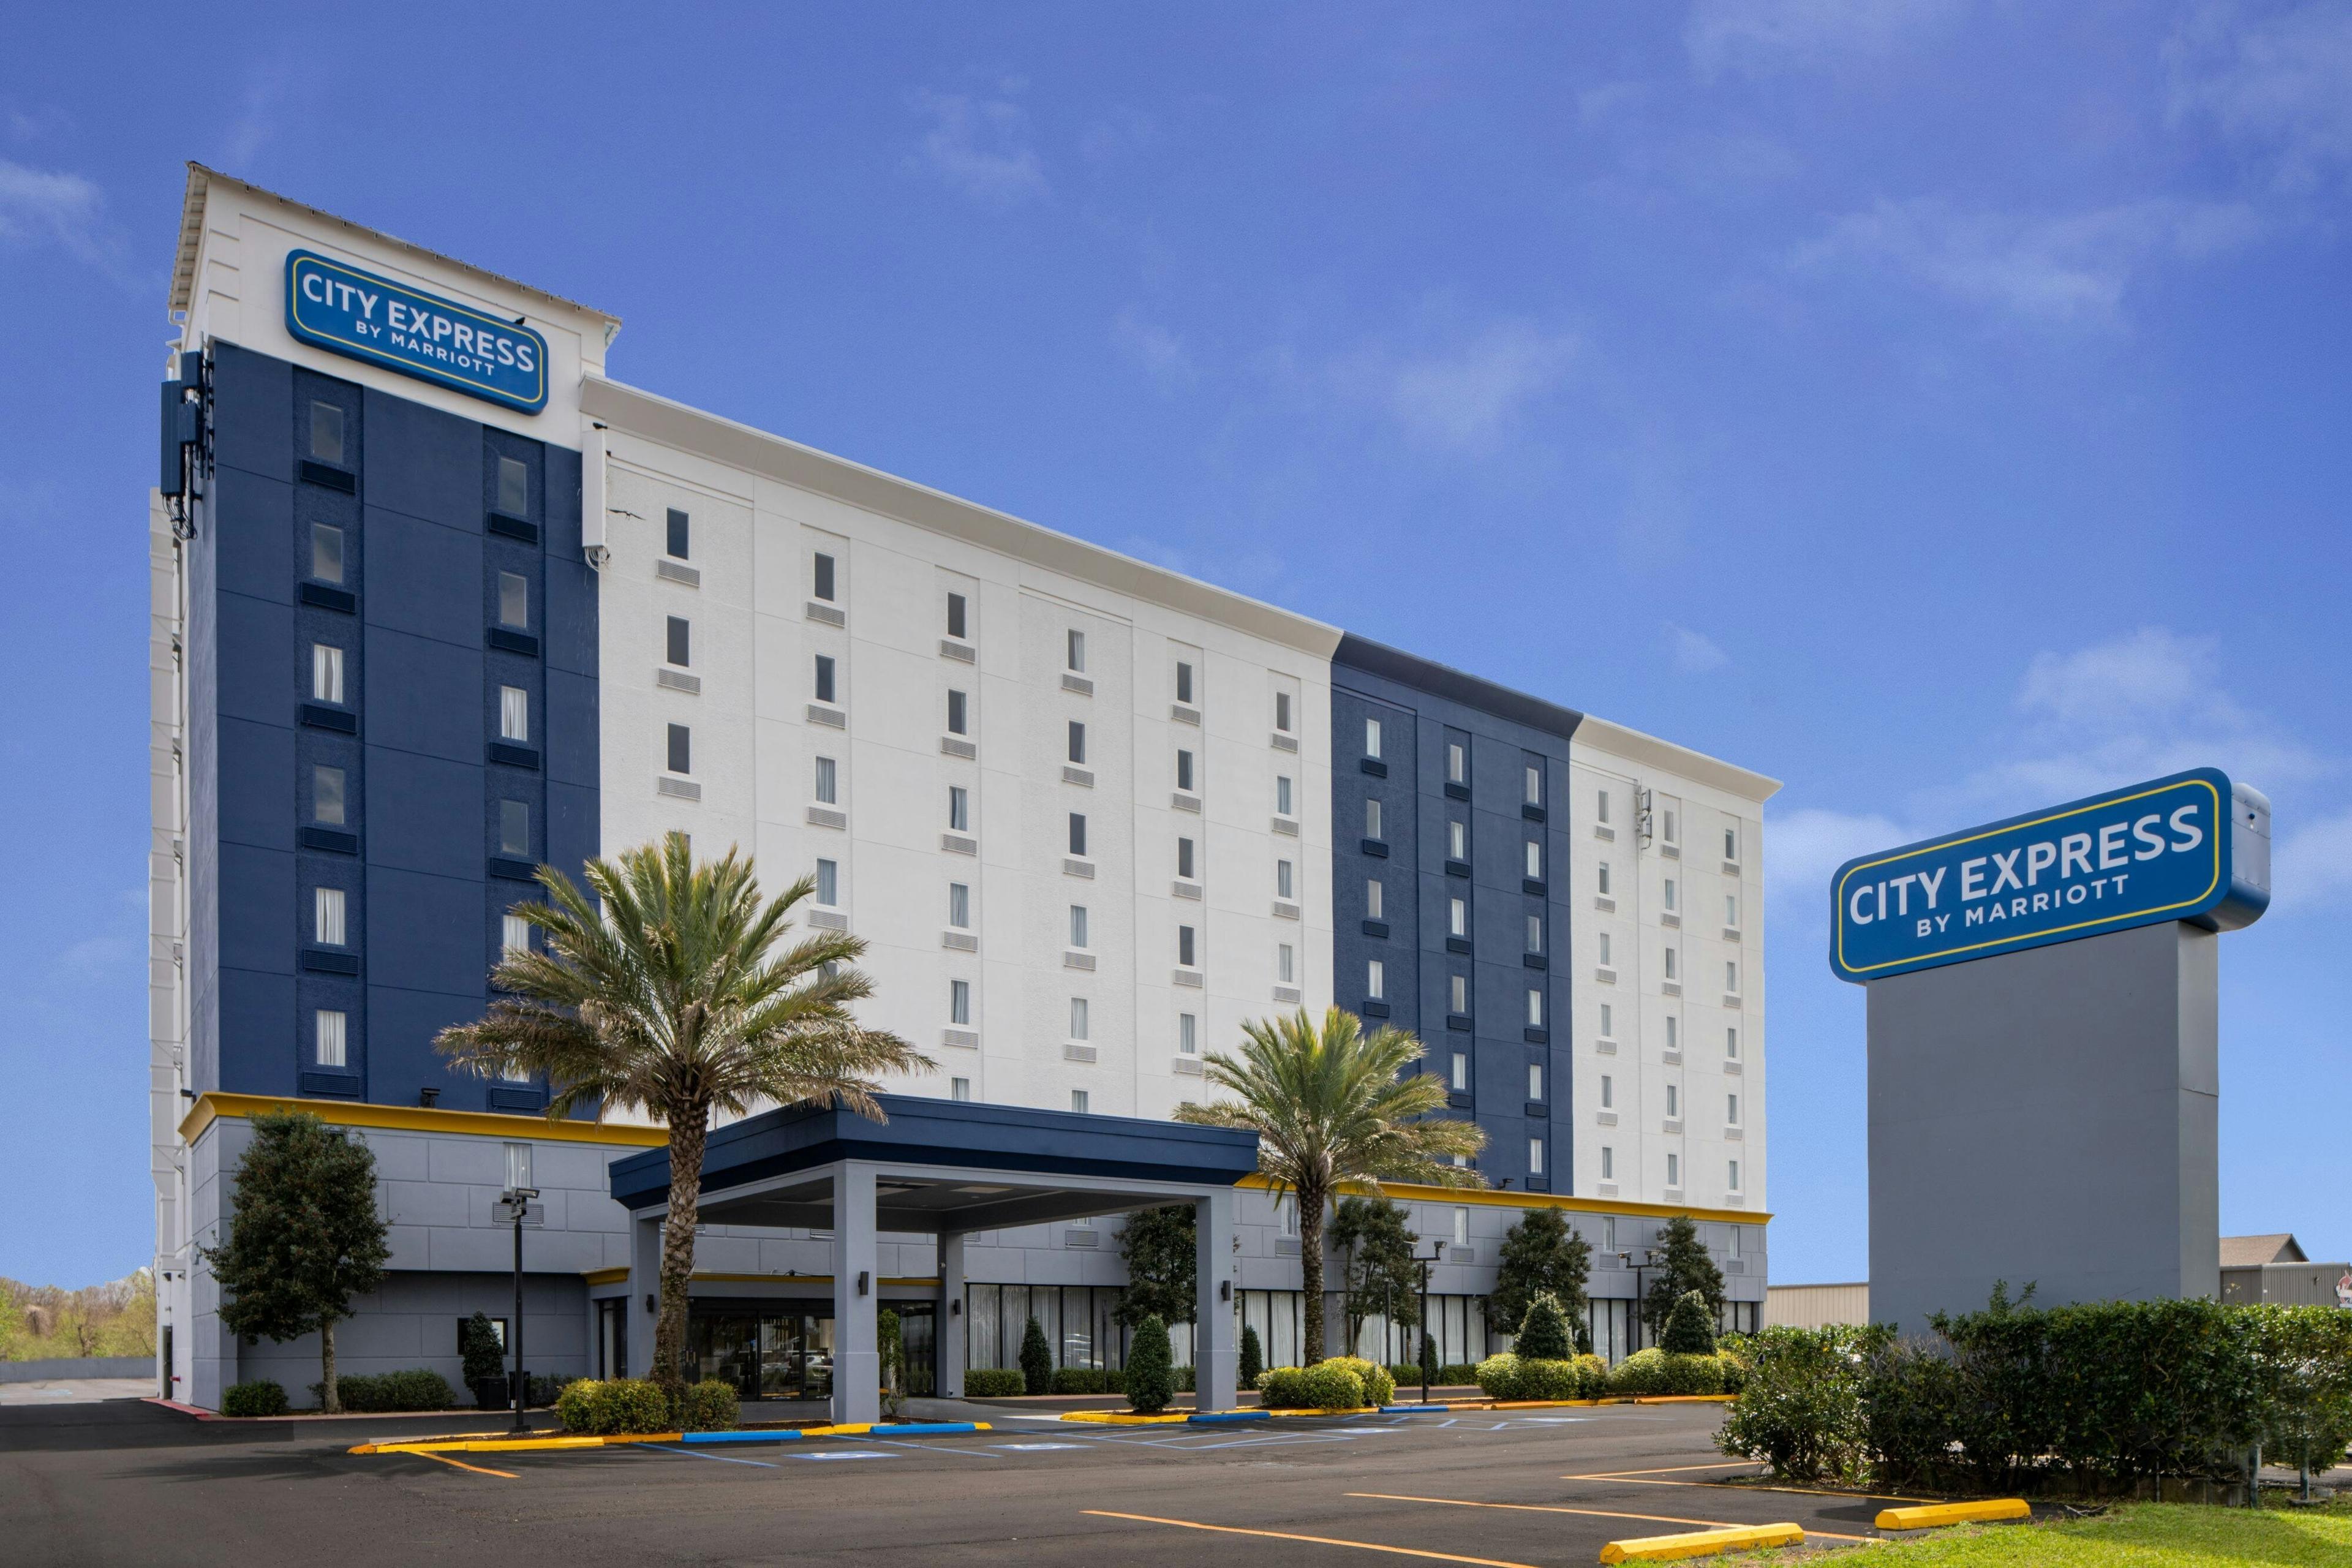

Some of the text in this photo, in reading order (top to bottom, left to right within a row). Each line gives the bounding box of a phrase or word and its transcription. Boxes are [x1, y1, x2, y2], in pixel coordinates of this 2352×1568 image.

[303, 274, 535, 372] CITY EXPRESS
[356, 320, 495, 375] BY MARRIOTT
[1850, 805, 2203, 924] CITY EXPRESS
[1917, 874, 2129, 937] BY MARRIOTT
